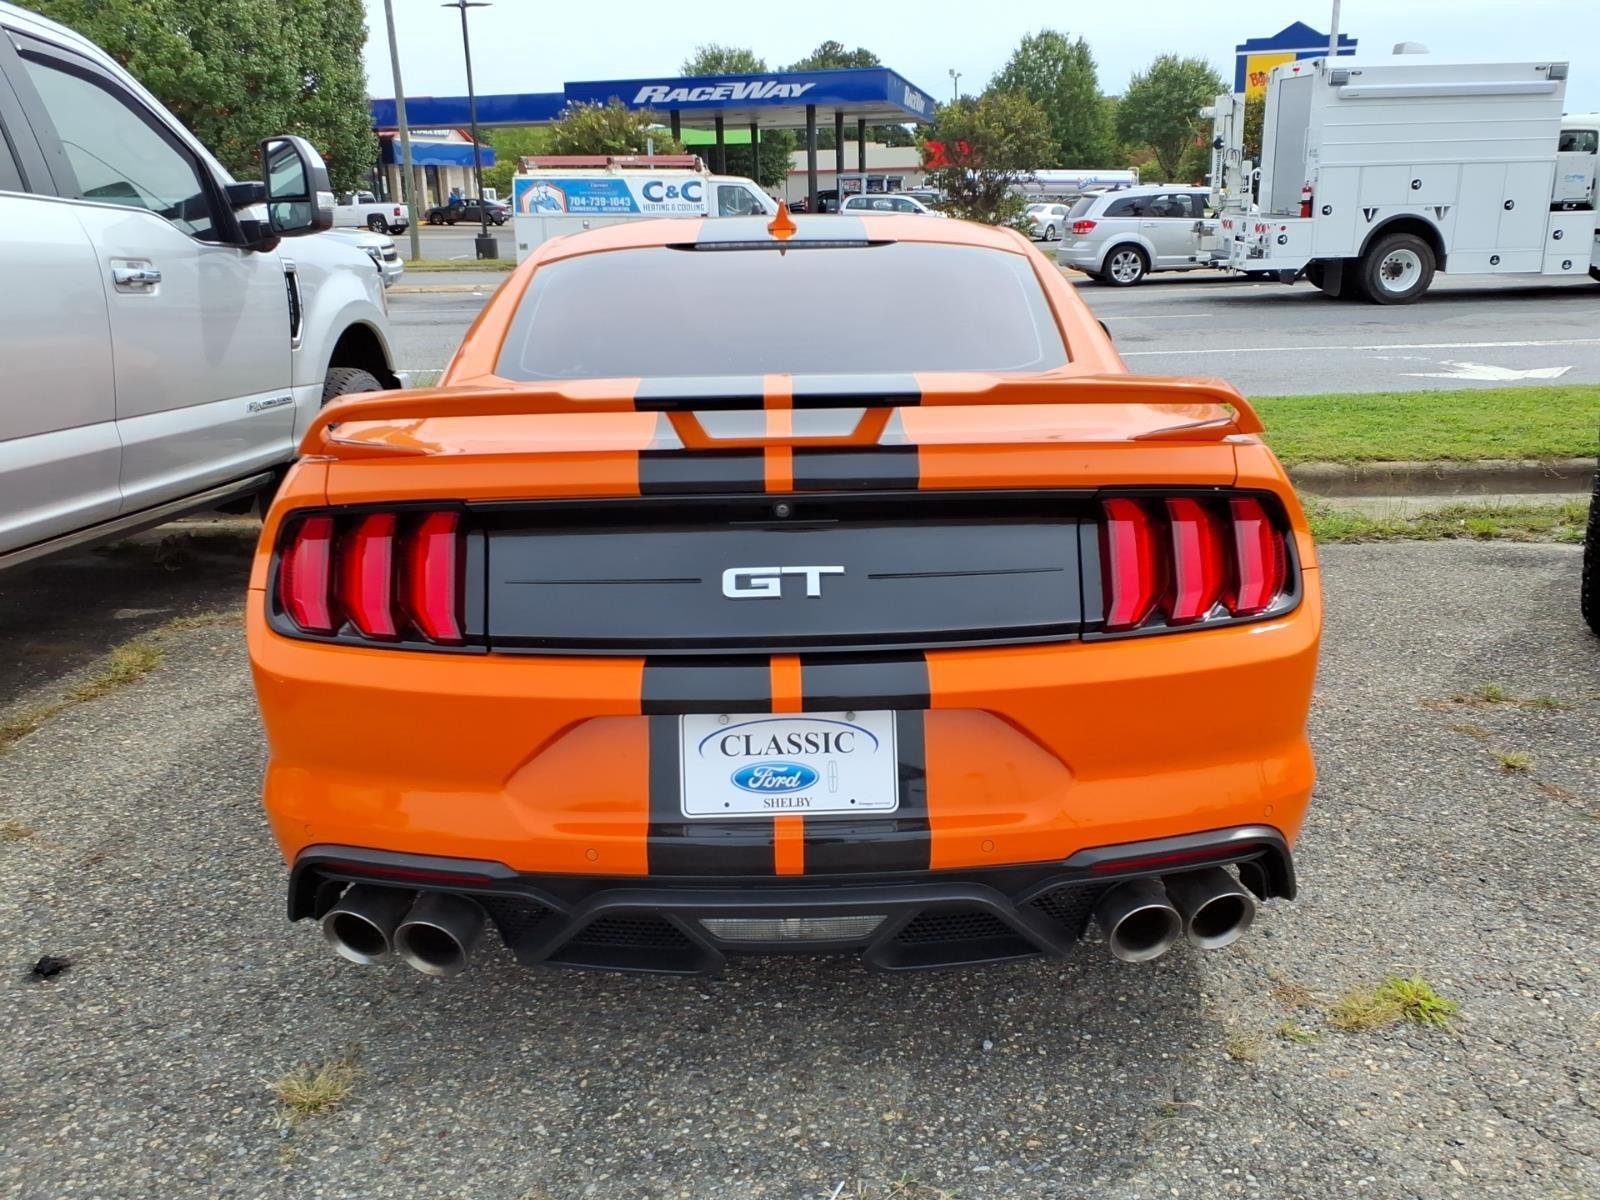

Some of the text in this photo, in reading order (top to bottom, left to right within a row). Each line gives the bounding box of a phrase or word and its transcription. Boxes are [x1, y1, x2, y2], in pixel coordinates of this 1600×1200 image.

[633, 80, 817, 104] RACEWAY
[642, 181, 702, 202] C&C
[722, 566, 845, 599] GT
[720, 731, 855, 757] CLASSIC
[748, 766, 801, 788] Ford
[763, 797, 813, 808] SHELBY
